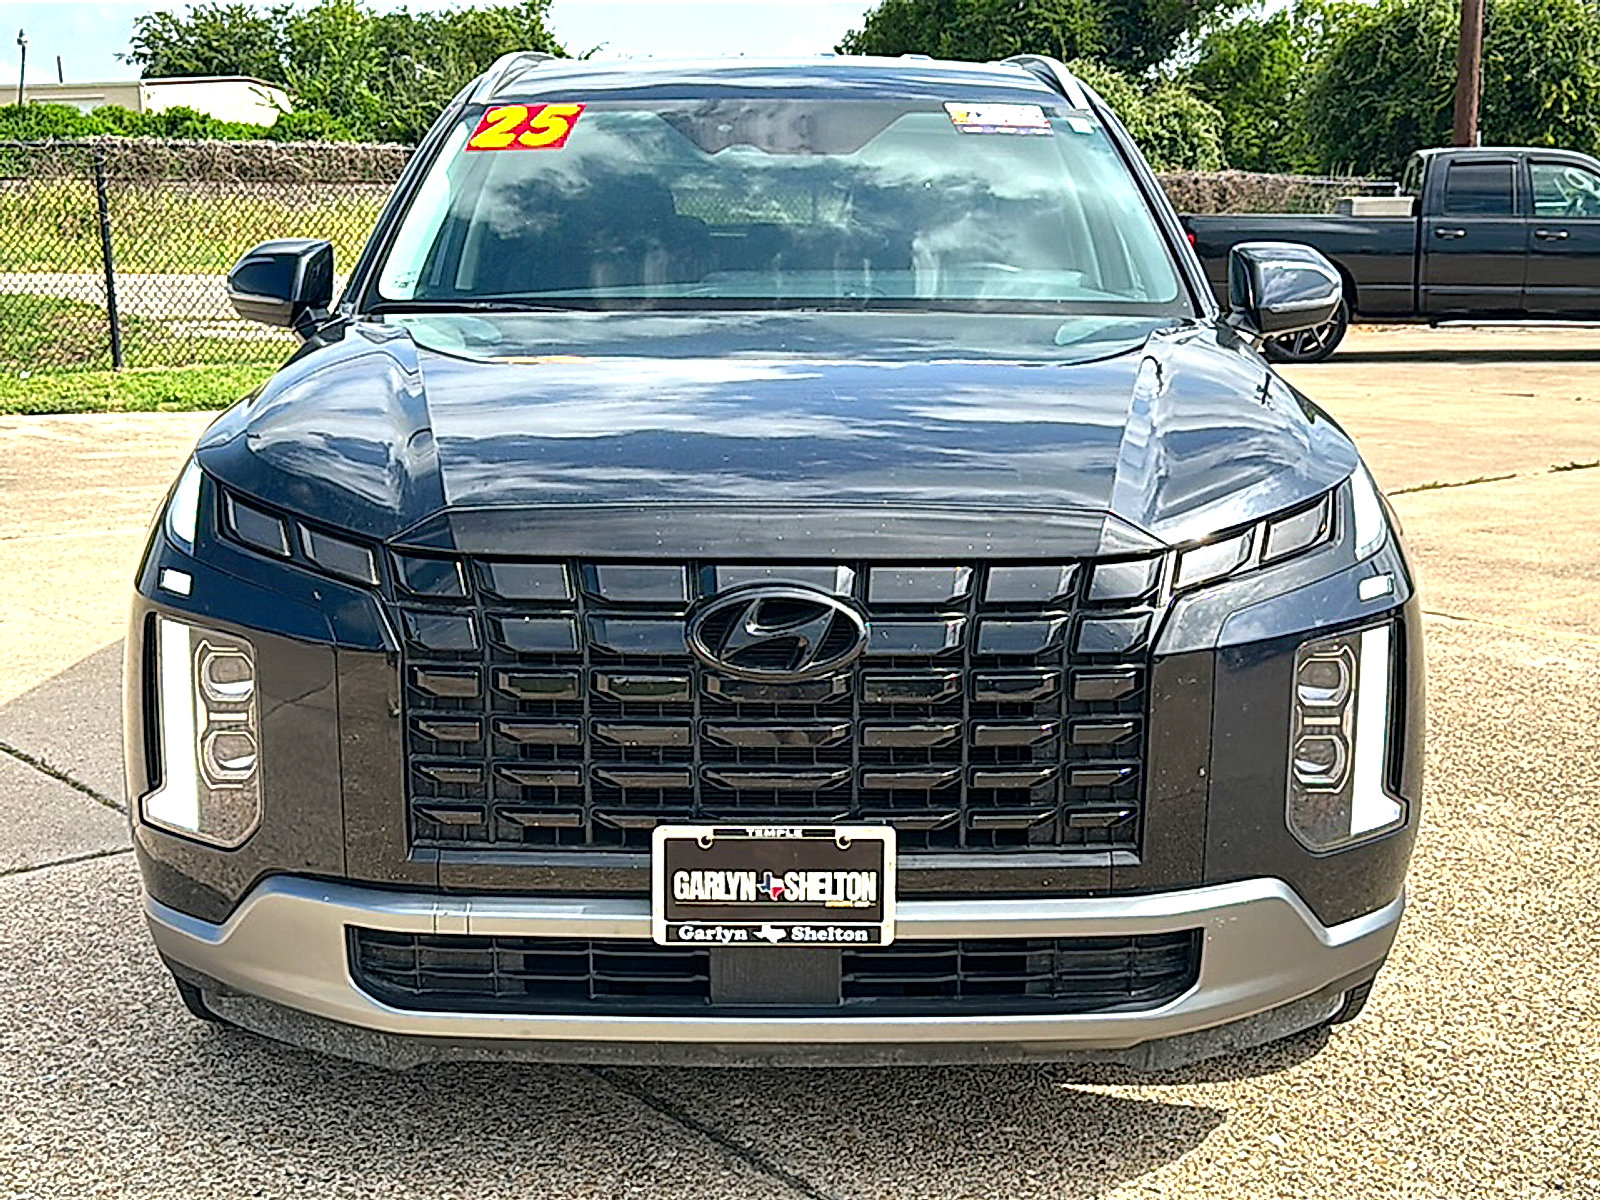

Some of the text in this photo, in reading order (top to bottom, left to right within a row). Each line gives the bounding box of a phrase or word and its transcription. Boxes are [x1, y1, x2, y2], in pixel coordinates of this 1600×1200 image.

[469, 104, 581, 148] 25
[746, 828, 803, 838] TEMPLE
[673, 871, 877, 901] GARLYN SHELTON
[678, 925, 868, 944] Garlyn Shelton
